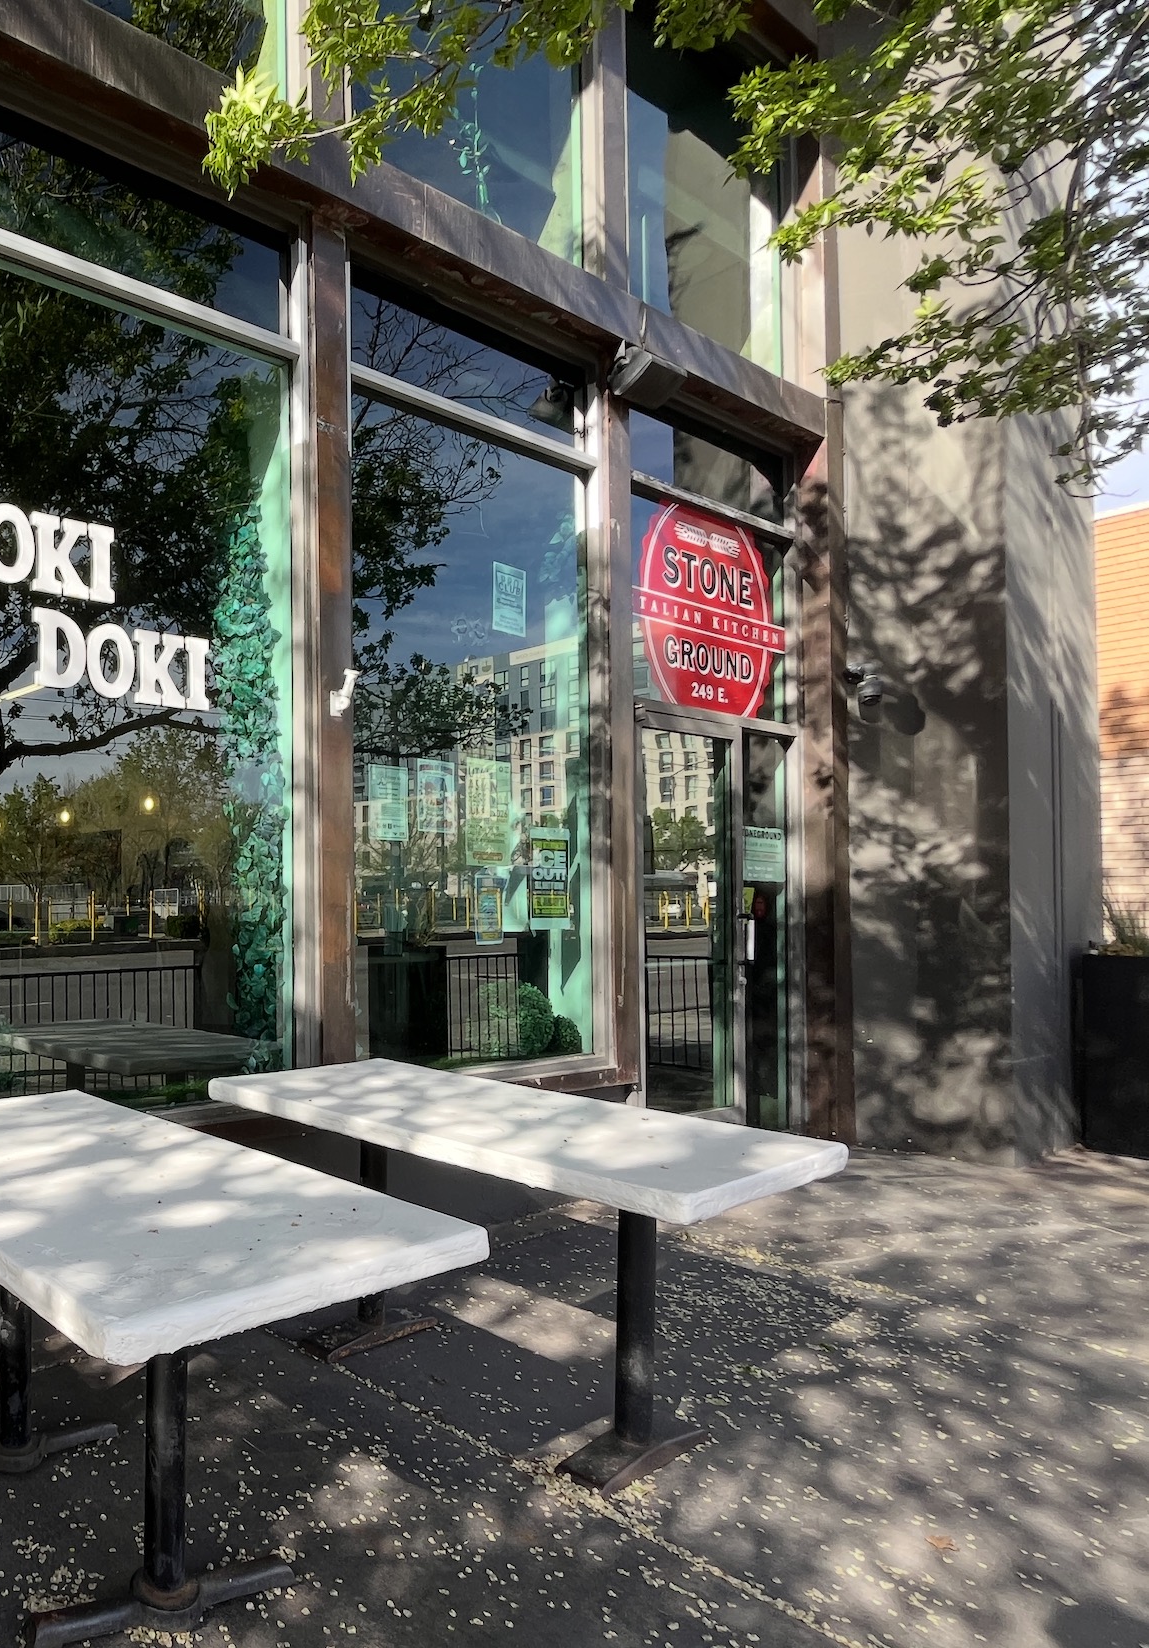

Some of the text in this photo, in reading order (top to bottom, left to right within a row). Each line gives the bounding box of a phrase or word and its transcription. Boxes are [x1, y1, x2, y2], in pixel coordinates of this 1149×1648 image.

[662, 544, 755, 611] STONE
[639, 595, 780, 645] TALIAN KITCHEN
[31, 606, 210, 711] DOKI
[663, 634, 755, 684] GROUND
[691, 681, 729, 704] 249 E.
[744, 828, 782, 841] ONEGROUND
